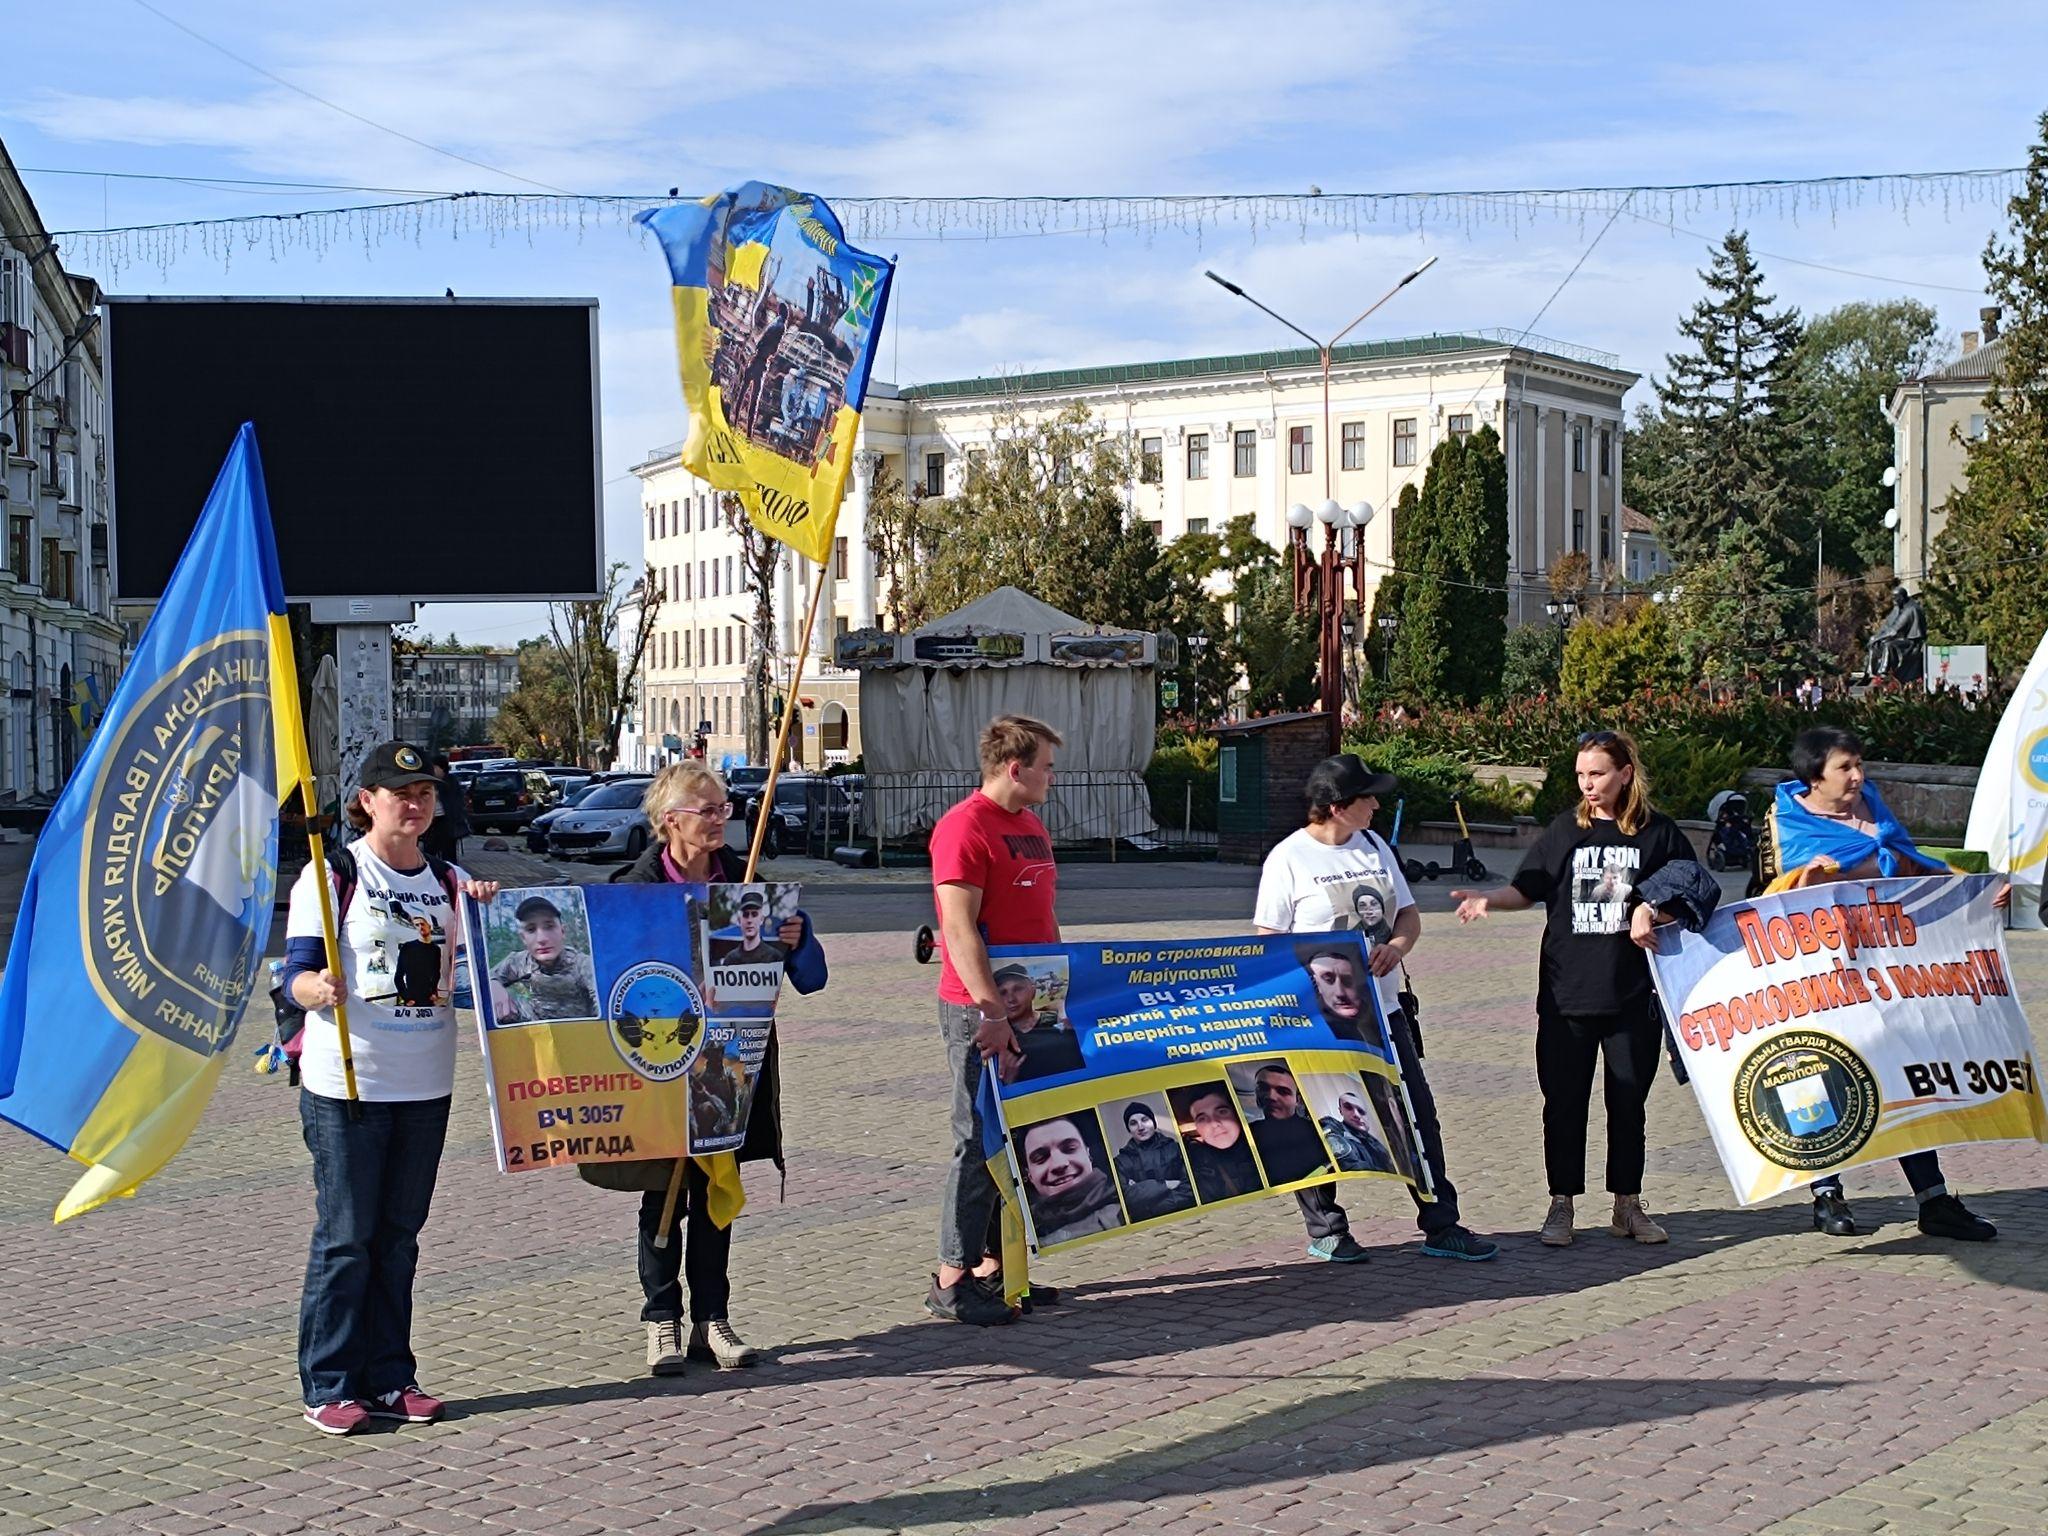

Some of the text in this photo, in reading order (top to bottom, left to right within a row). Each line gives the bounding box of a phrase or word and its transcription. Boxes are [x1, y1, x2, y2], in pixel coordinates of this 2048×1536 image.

[1573, 846, 1640, 869] MY SON
[1573, 902, 1598, 922] WE
[1734, 886, 1917, 968] Поверніть
[1101, 942, 1265, 965] Волю строковикам
[713, 970, 779, 987] ПОЛОНІ
[1128, 964, 1238, 986] Маріуполя!!!
[614, 968, 701, 1014] ВОЛЮ ЗАХИСНИКАМ
[1138, 983, 1237, 1007] ВЧ 3057
[1679, 957, 1872, 1052] строковиків
[1867, 967, 1892, 1000] з
[1096, 1006, 1166, 1029] другий
[1168, 1000, 1201, 1020] рік
[1203, 1003, 1216, 1015] в
[708, 1028, 736, 1041] 3057
[1093, 1011, 1314, 1048] Поверніть наших дітей
[629, 1045, 696, 1075] МАРІУПОЛЯ
[1779, 1035, 1828, 1049] ГВАРДІЯ
[1829, 1042, 1867, 1080] УКРАЇНИ
[507, 1073, 645, 1101] ПОВЕРНІТЬ
[1762, 1061, 1830, 1089] МАРІУПОЛЬ
[1903, 1059, 2034, 1098] ВЧ 3057
[538, 1104, 624, 1129] ВЧ 3057
[504, 1135, 635, 1166] 2 БРИГАДА
